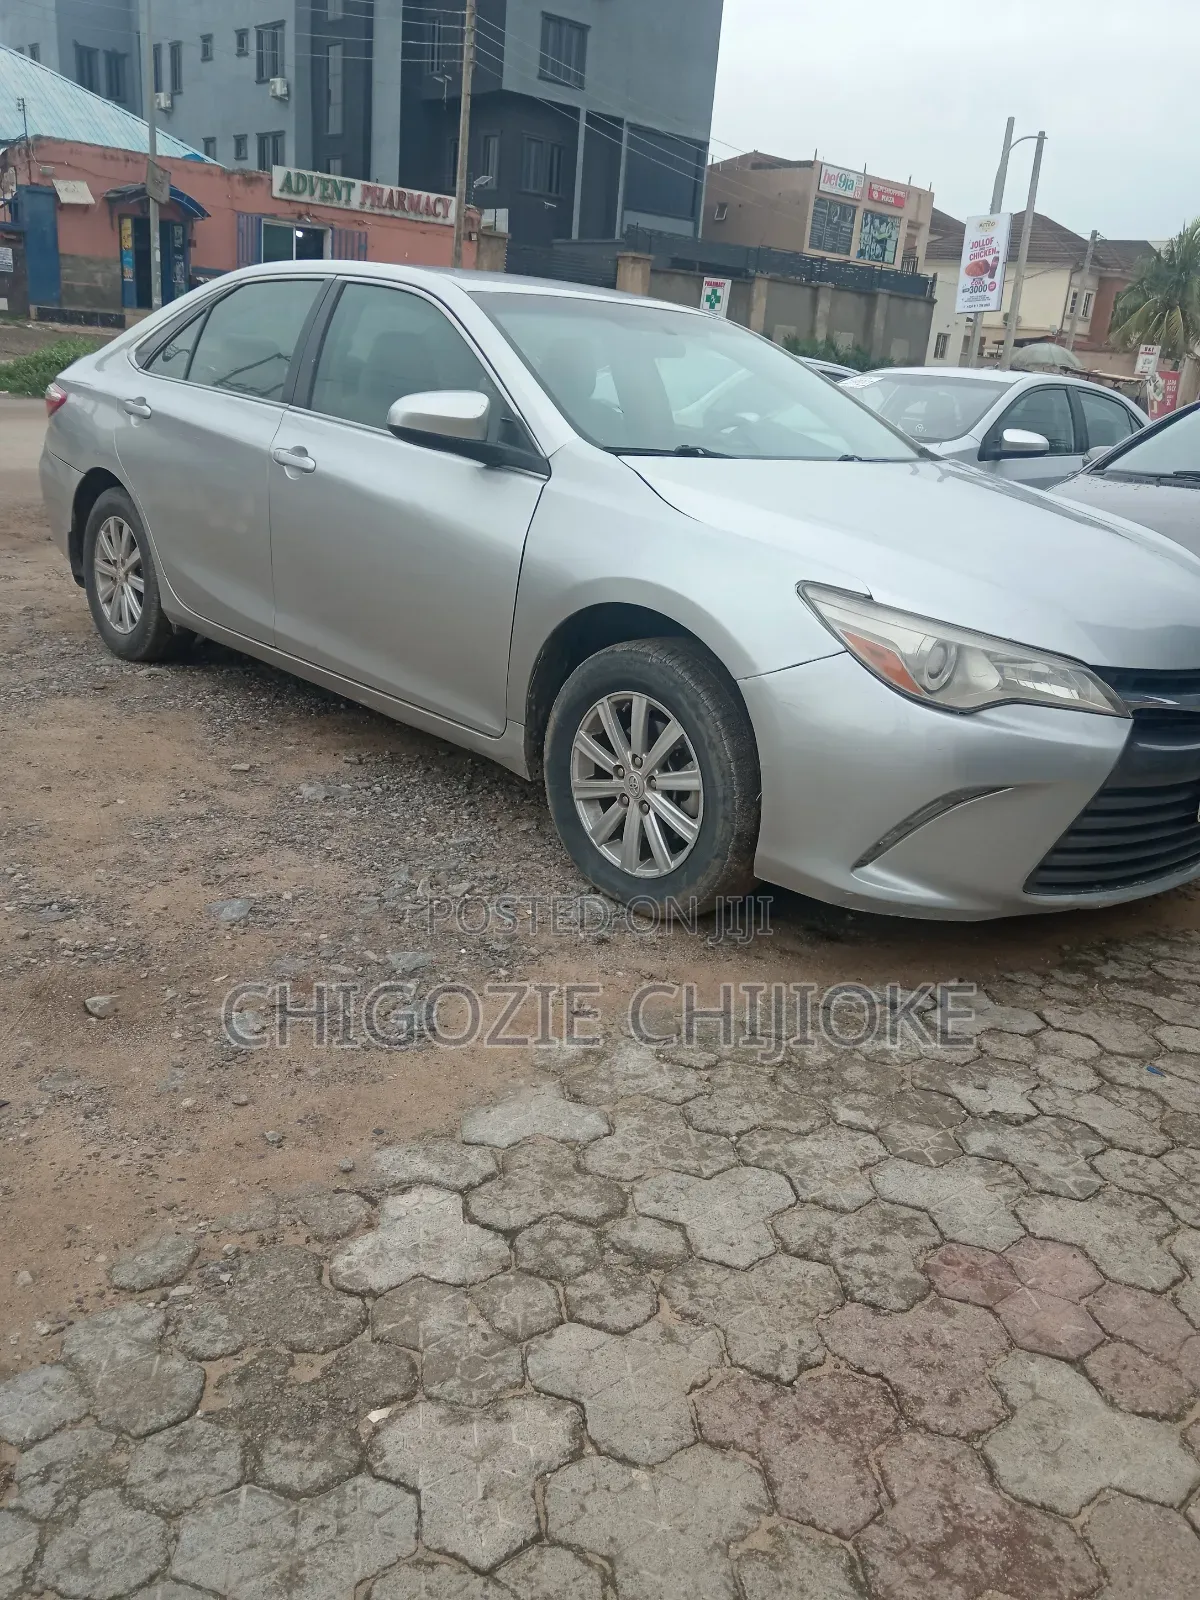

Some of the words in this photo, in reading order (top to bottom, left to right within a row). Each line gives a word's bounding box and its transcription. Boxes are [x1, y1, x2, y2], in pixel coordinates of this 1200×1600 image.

[822, 168, 855, 192] bet9ja
[279, 170, 356, 202] ADVENT
[359, 183, 454, 219] PHARMACY
[970, 236, 995, 250] JOLLOF
[969, 247, 997, 261] CHICKEN
[705, 280, 726, 288] PHARMACY
[969, 284, 988, 294] 3000
